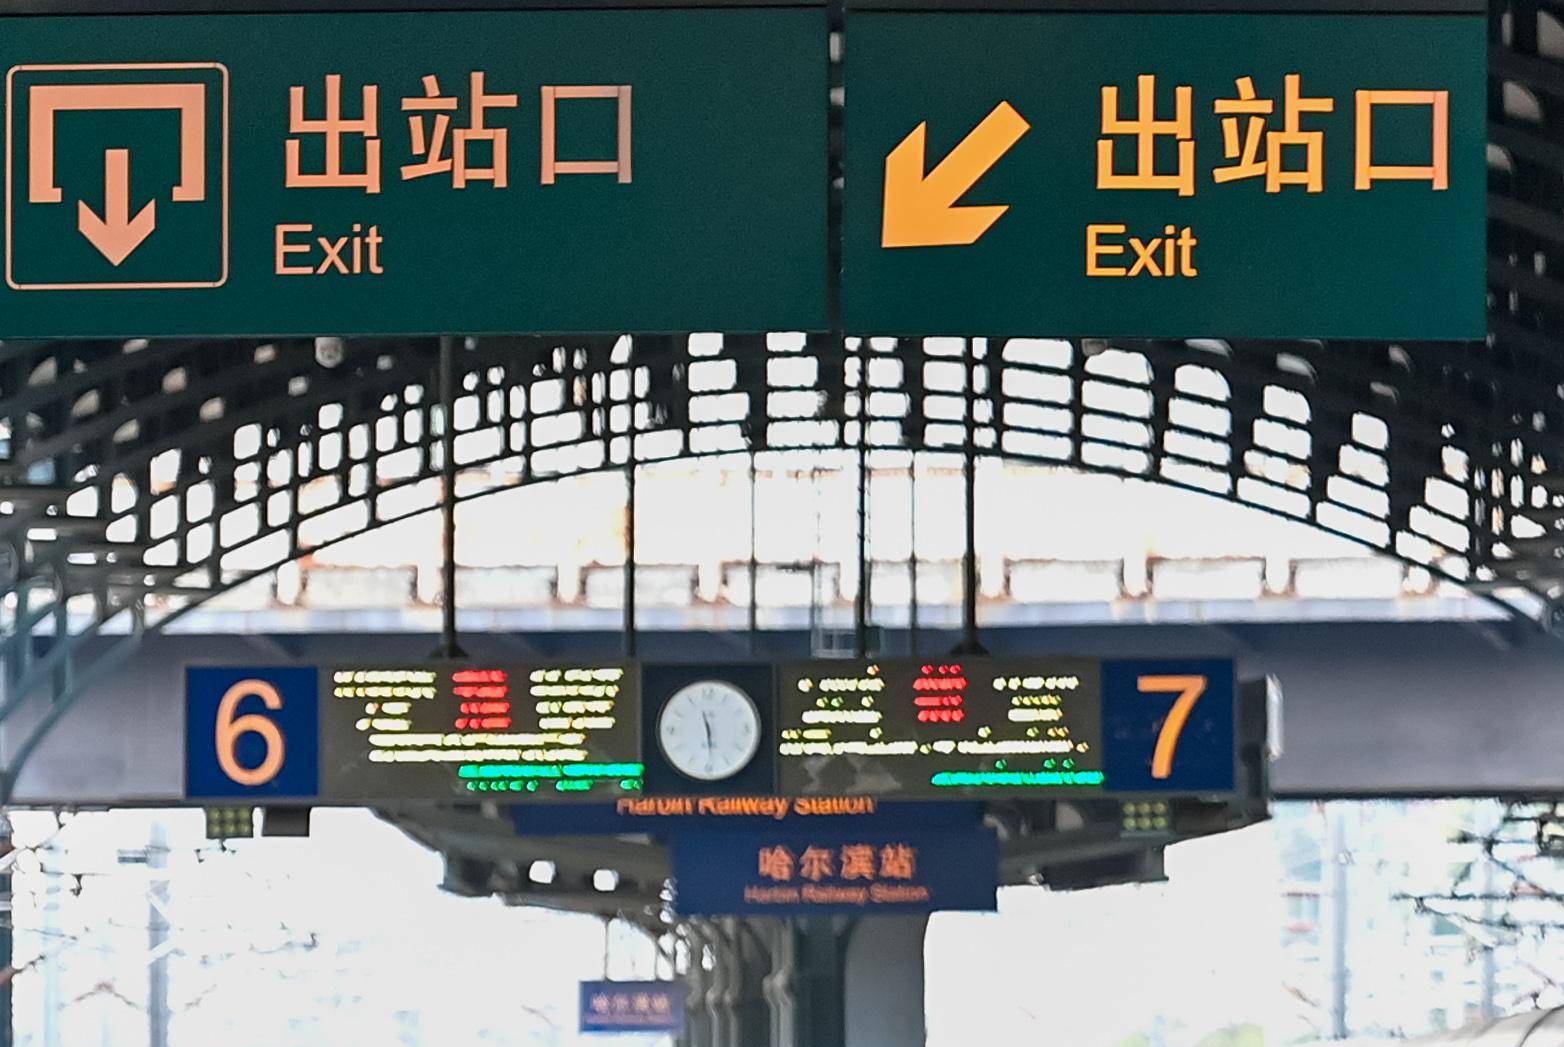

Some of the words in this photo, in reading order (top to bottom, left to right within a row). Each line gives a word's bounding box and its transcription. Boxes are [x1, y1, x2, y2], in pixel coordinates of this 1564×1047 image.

[285, 71, 632, 194] 出站口
[1096, 74, 1450, 197] 出站口
[275, 223, 384, 275] Exit
[1086, 225, 1198, 277] Exit
[215, 679, 285, 786] 6
[1136, 675, 1207, 780] 7
[793, 797, 874, 815] Station
[758, 843, 916, 881] 哈尔滨站
